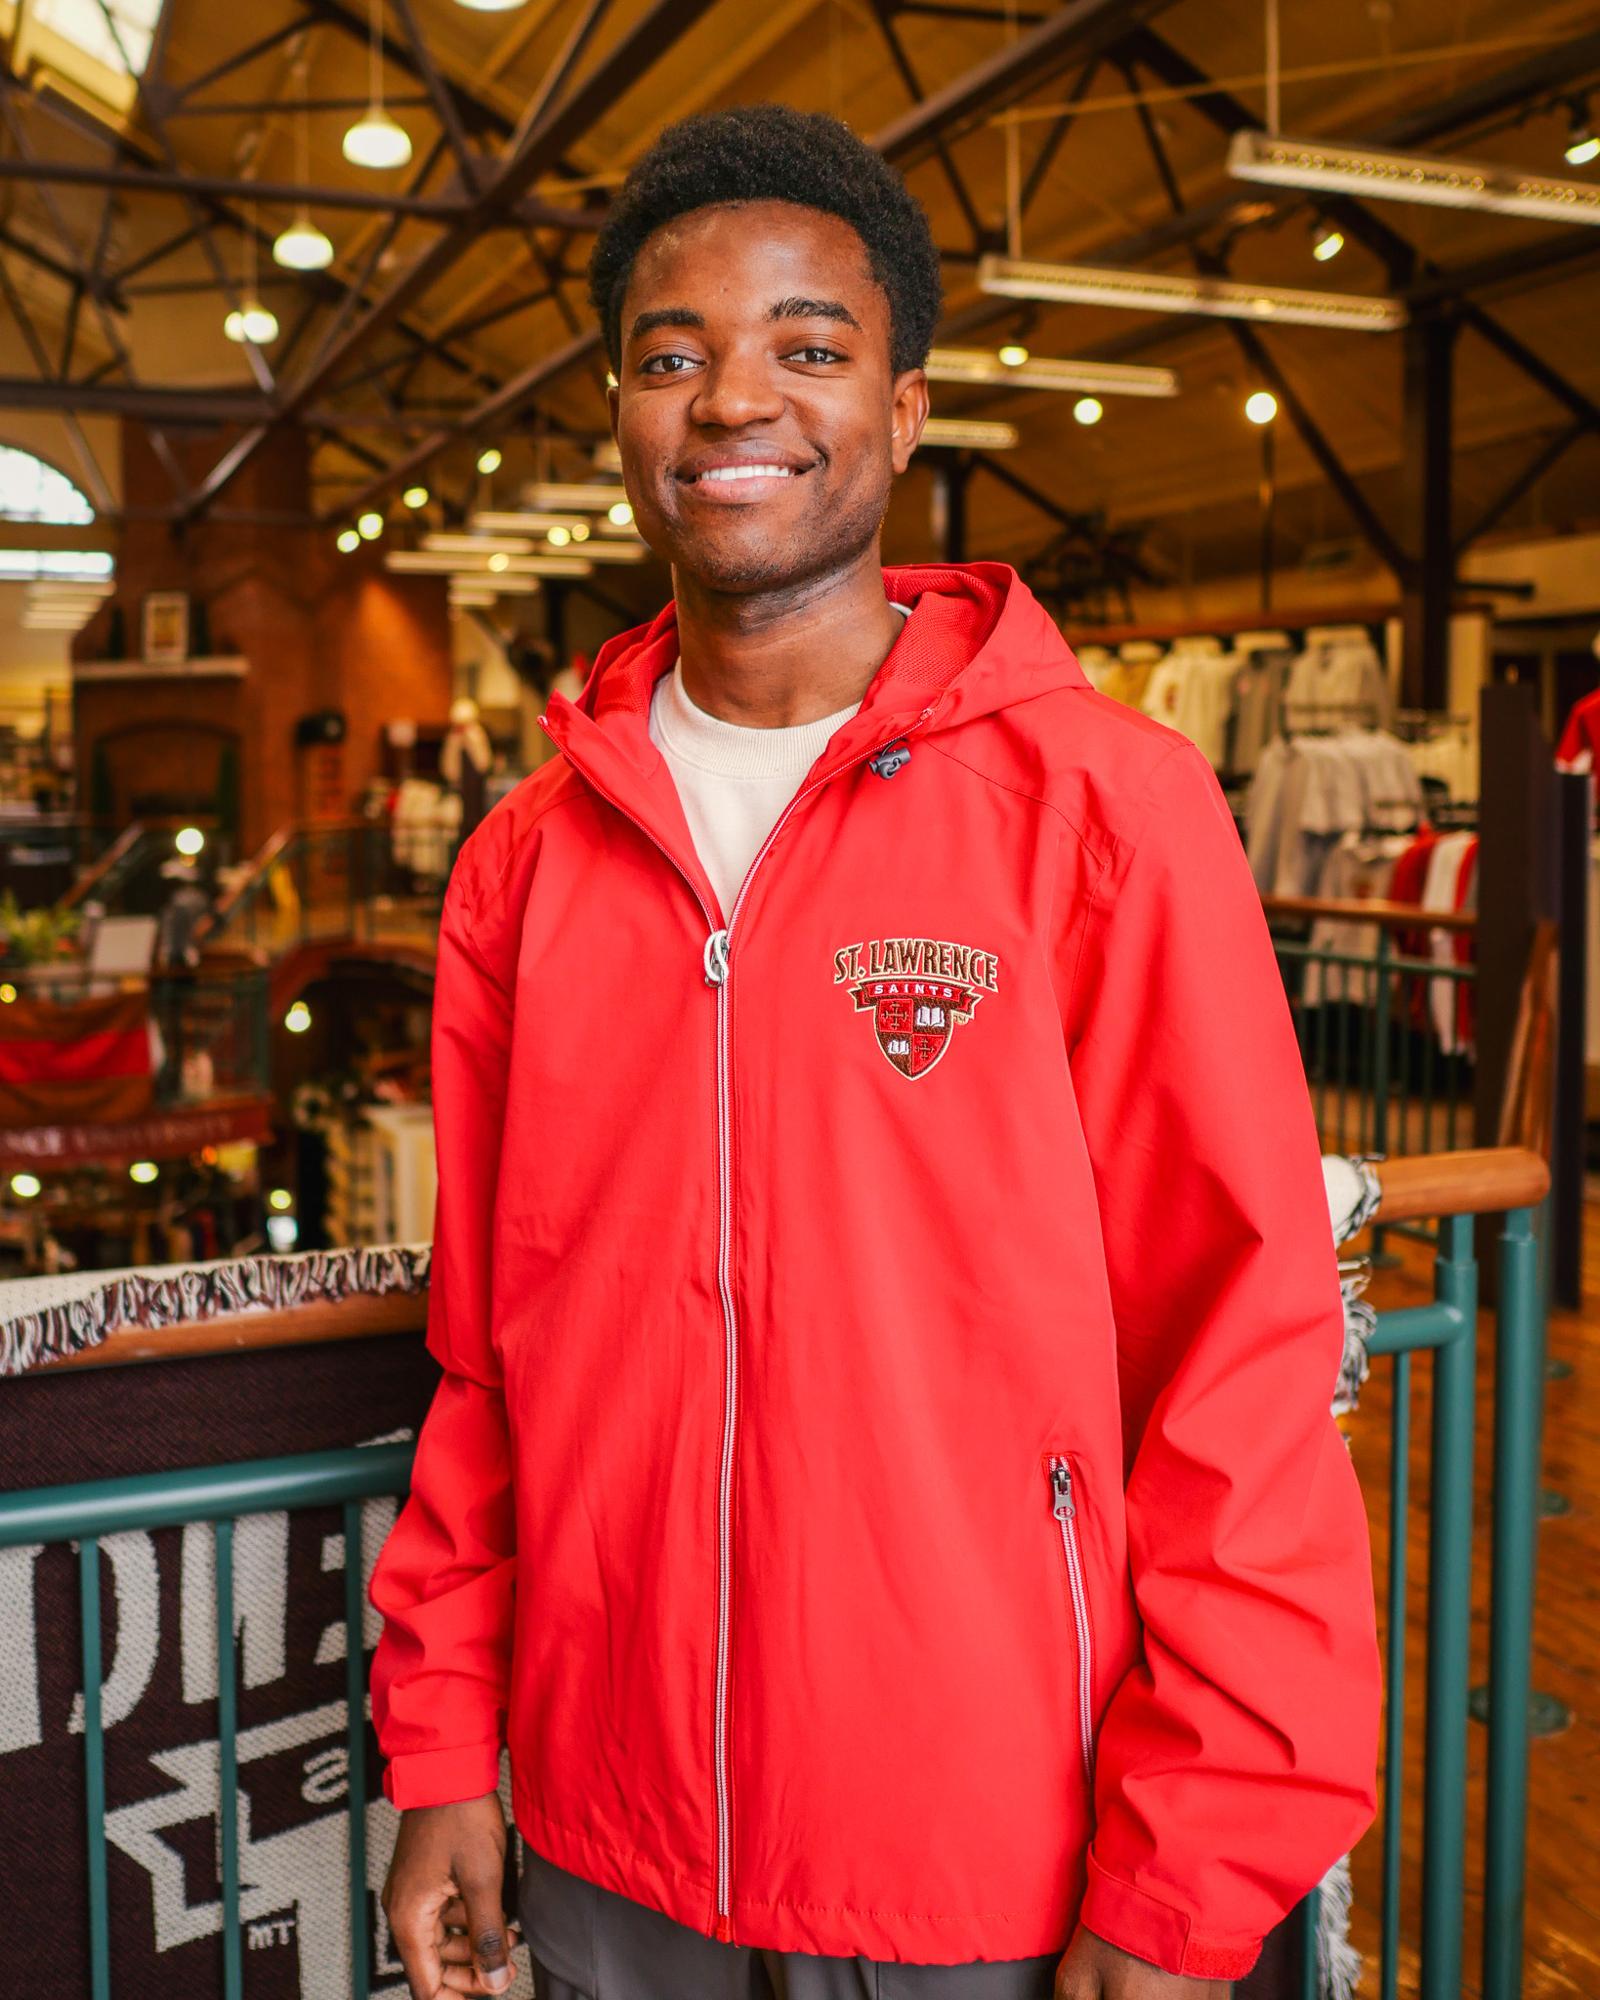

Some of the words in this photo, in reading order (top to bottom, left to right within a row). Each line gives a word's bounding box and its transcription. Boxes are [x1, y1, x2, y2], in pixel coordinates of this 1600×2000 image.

[833, 942, 867, 985] ST.
[869, 938, 999, 992] LAWRENCE
[874, 984, 953, 998] SAINTS
